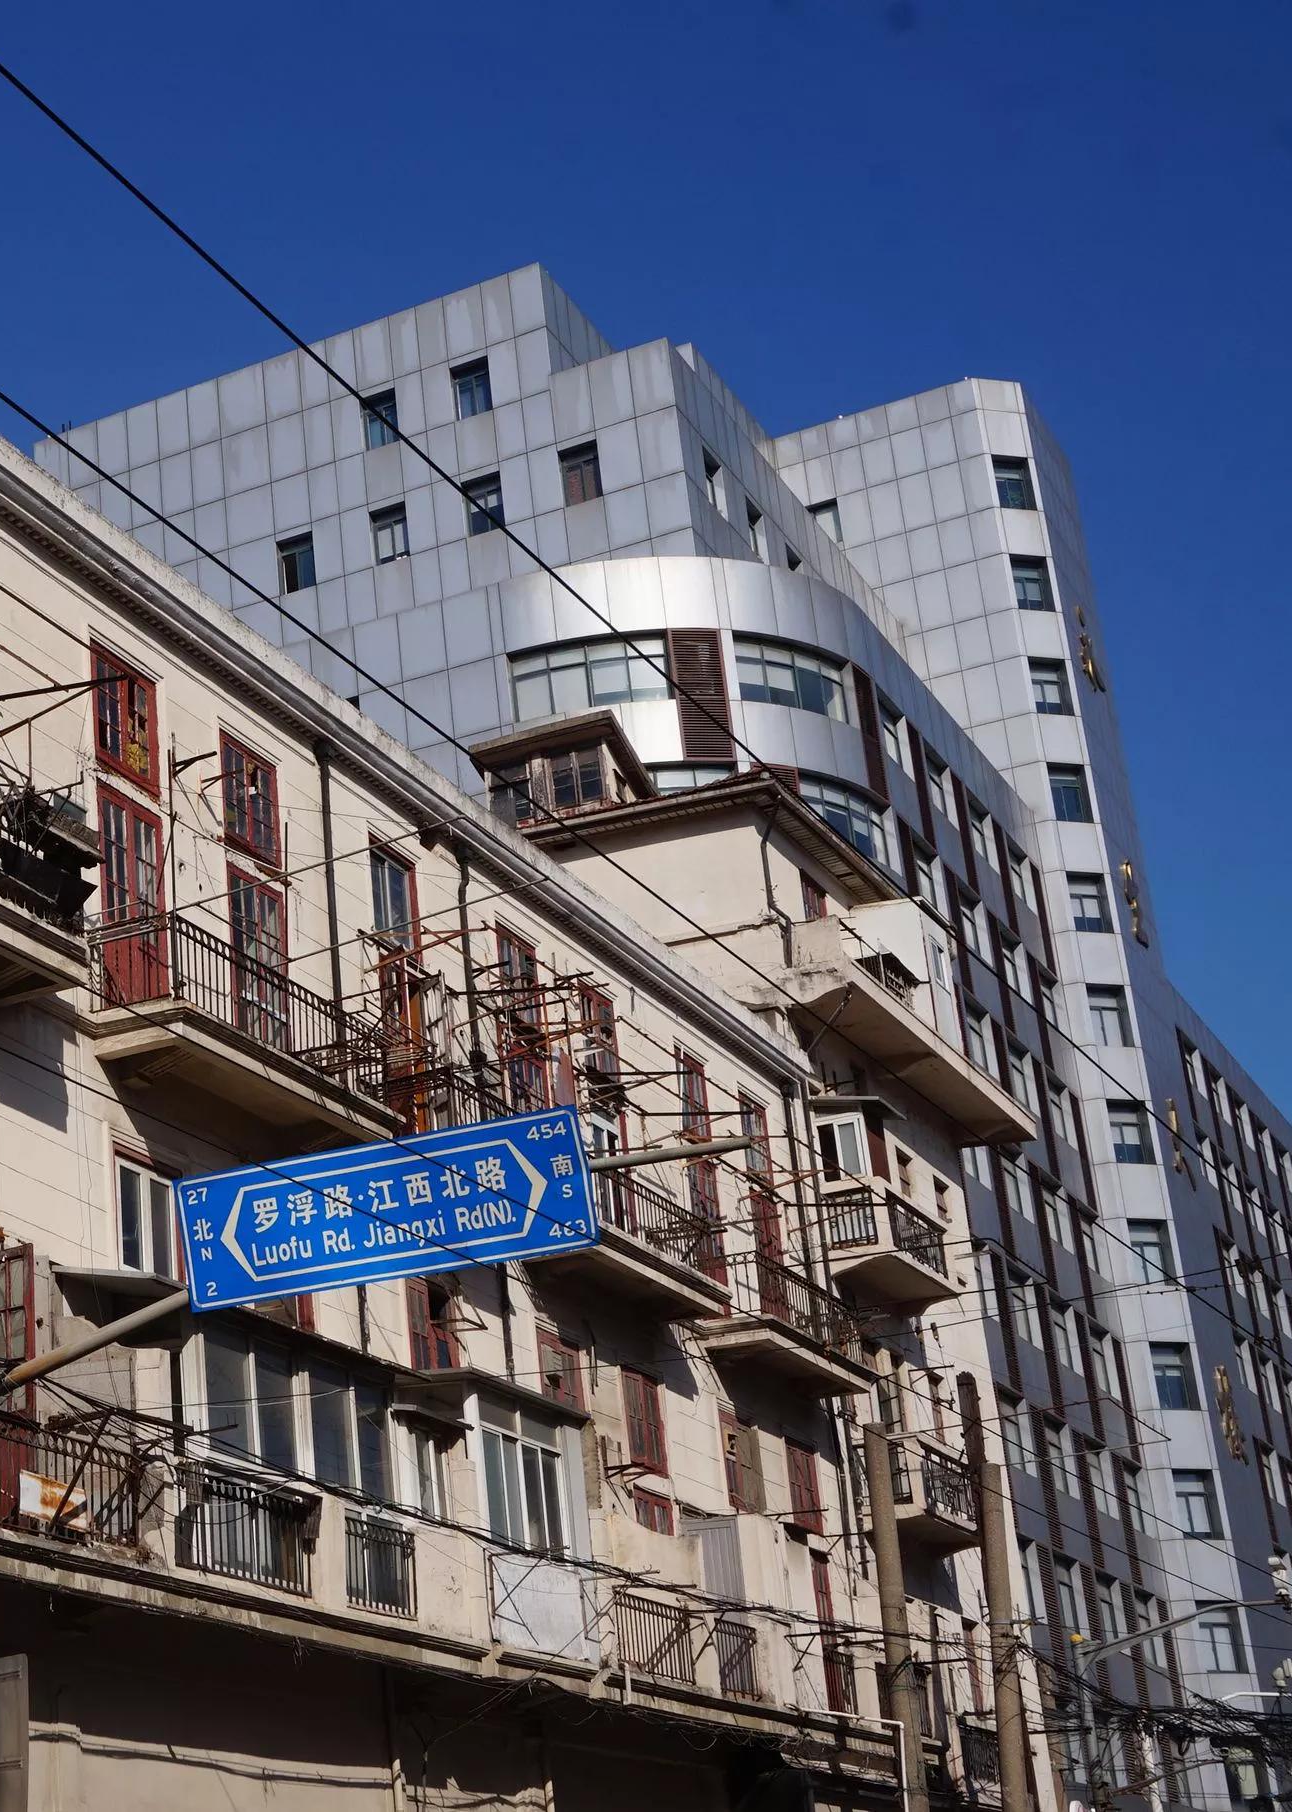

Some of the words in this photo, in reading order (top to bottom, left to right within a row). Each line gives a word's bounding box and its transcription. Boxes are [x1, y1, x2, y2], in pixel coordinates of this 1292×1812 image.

[526, 1121, 567, 1141] 454
[549, 1153, 574, 1179] 南
[186, 1187, 208, 1205] 27
[562, 1184, 573, 1198] S
[193, 1218, 214, 1242] 北
[251, 1235, 313, 1267] Luofu
[321, 1227, 356, 1255] Rd.
[363, 1209, 447, 1248] Jiangxi
[454, 1199, 517, 1233] Rd(N).
[549, 1219, 587, 1238] 463
[201, 1246, 213, 1261] N
[206, 1281, 219, 1297] 2
